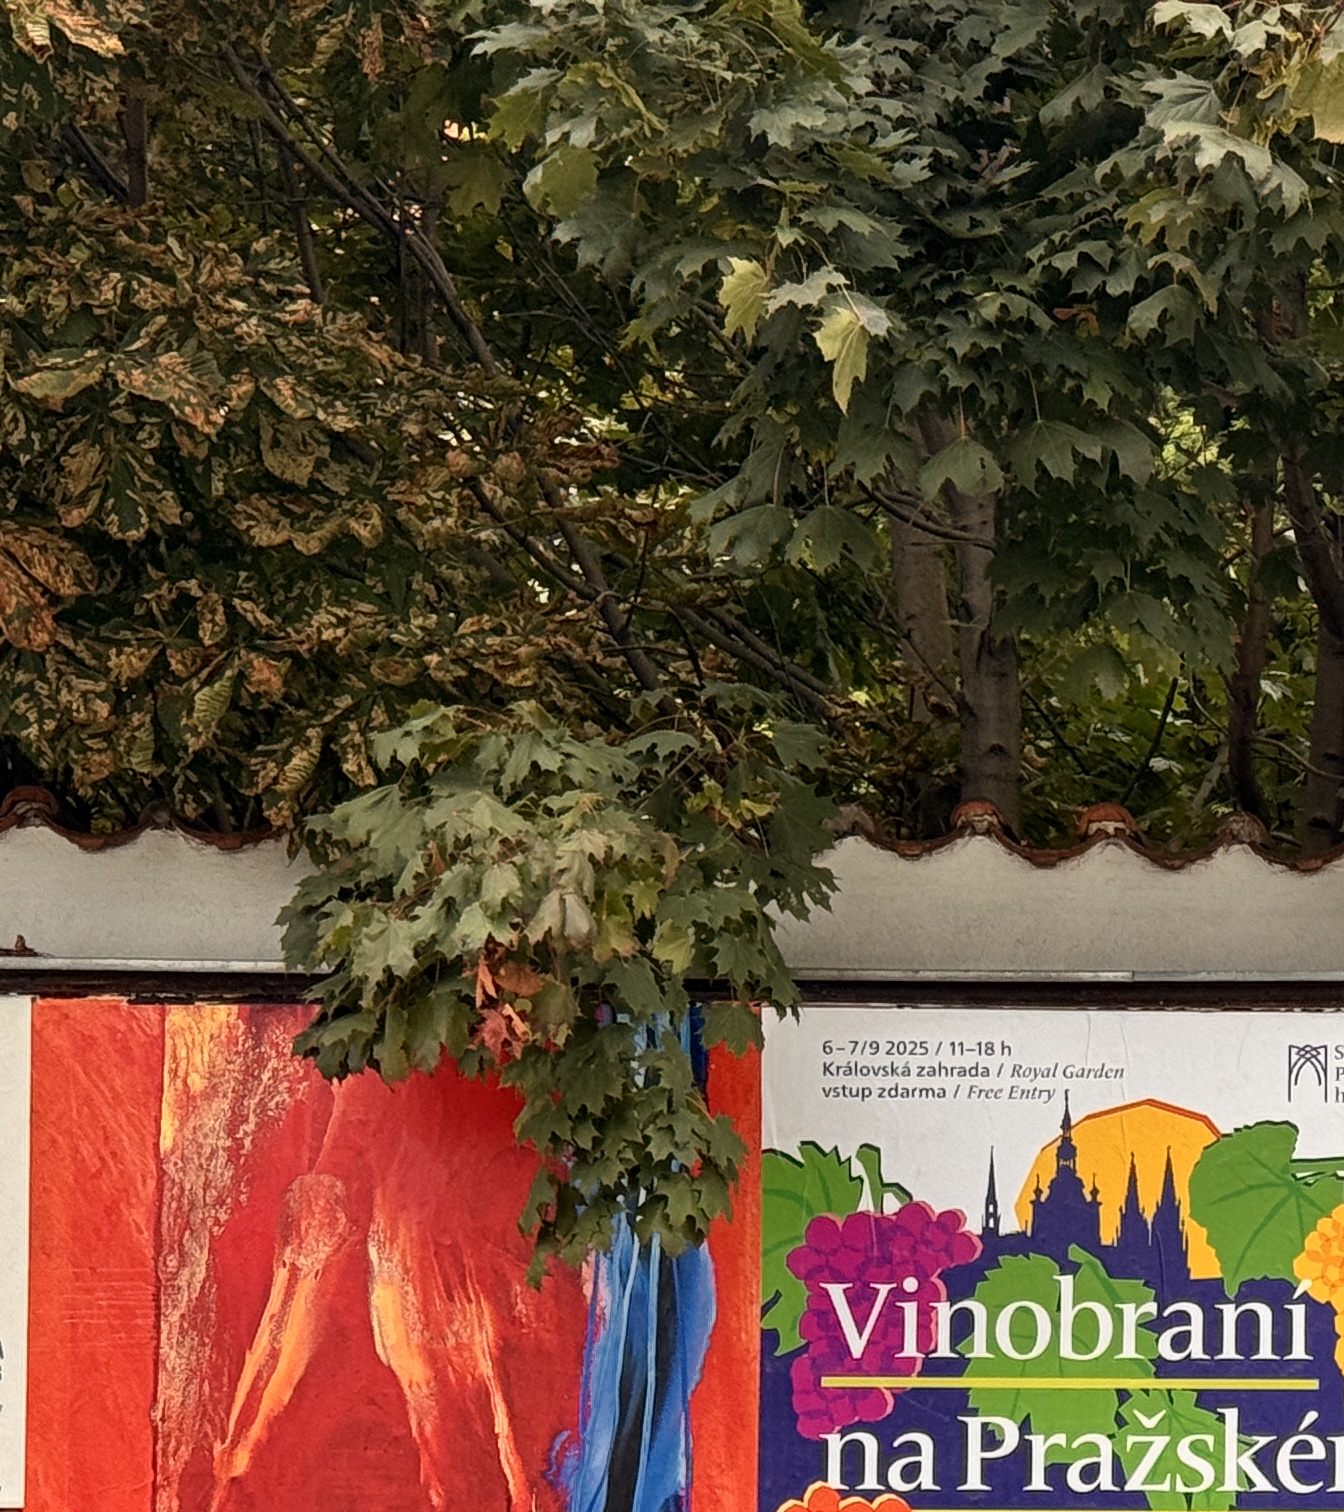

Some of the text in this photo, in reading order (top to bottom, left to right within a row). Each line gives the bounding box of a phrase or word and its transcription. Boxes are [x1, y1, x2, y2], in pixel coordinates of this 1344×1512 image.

[822, 1060, 1125, 1083] Královská zahrada / Royal Garden
[820, 1274, 1313, 1361] Vinobraní
[819, 1433, 942, 1492] na
